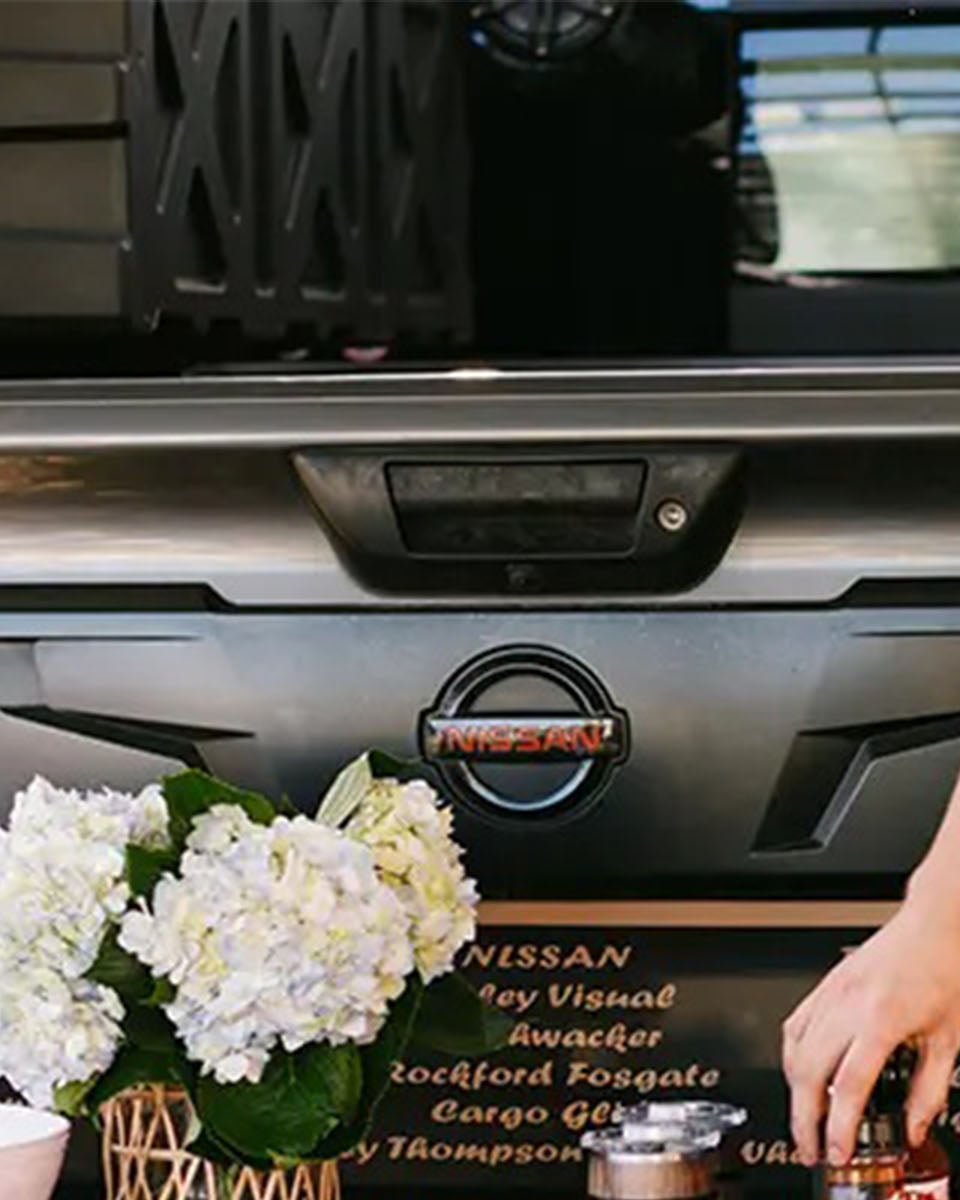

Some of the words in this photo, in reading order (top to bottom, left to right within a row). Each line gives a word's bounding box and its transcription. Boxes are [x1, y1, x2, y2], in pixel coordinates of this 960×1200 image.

[436, 723, 602, 752] NISSAN
[461, 944, 632, 968] NISSAN
[548, 983, 676, 1011] Visual
[566, 1061, 720, 1093] Fosgate
[431, 1099, 549, 1130] Cargo
[387, 1136, 582, 1166] Thompson
